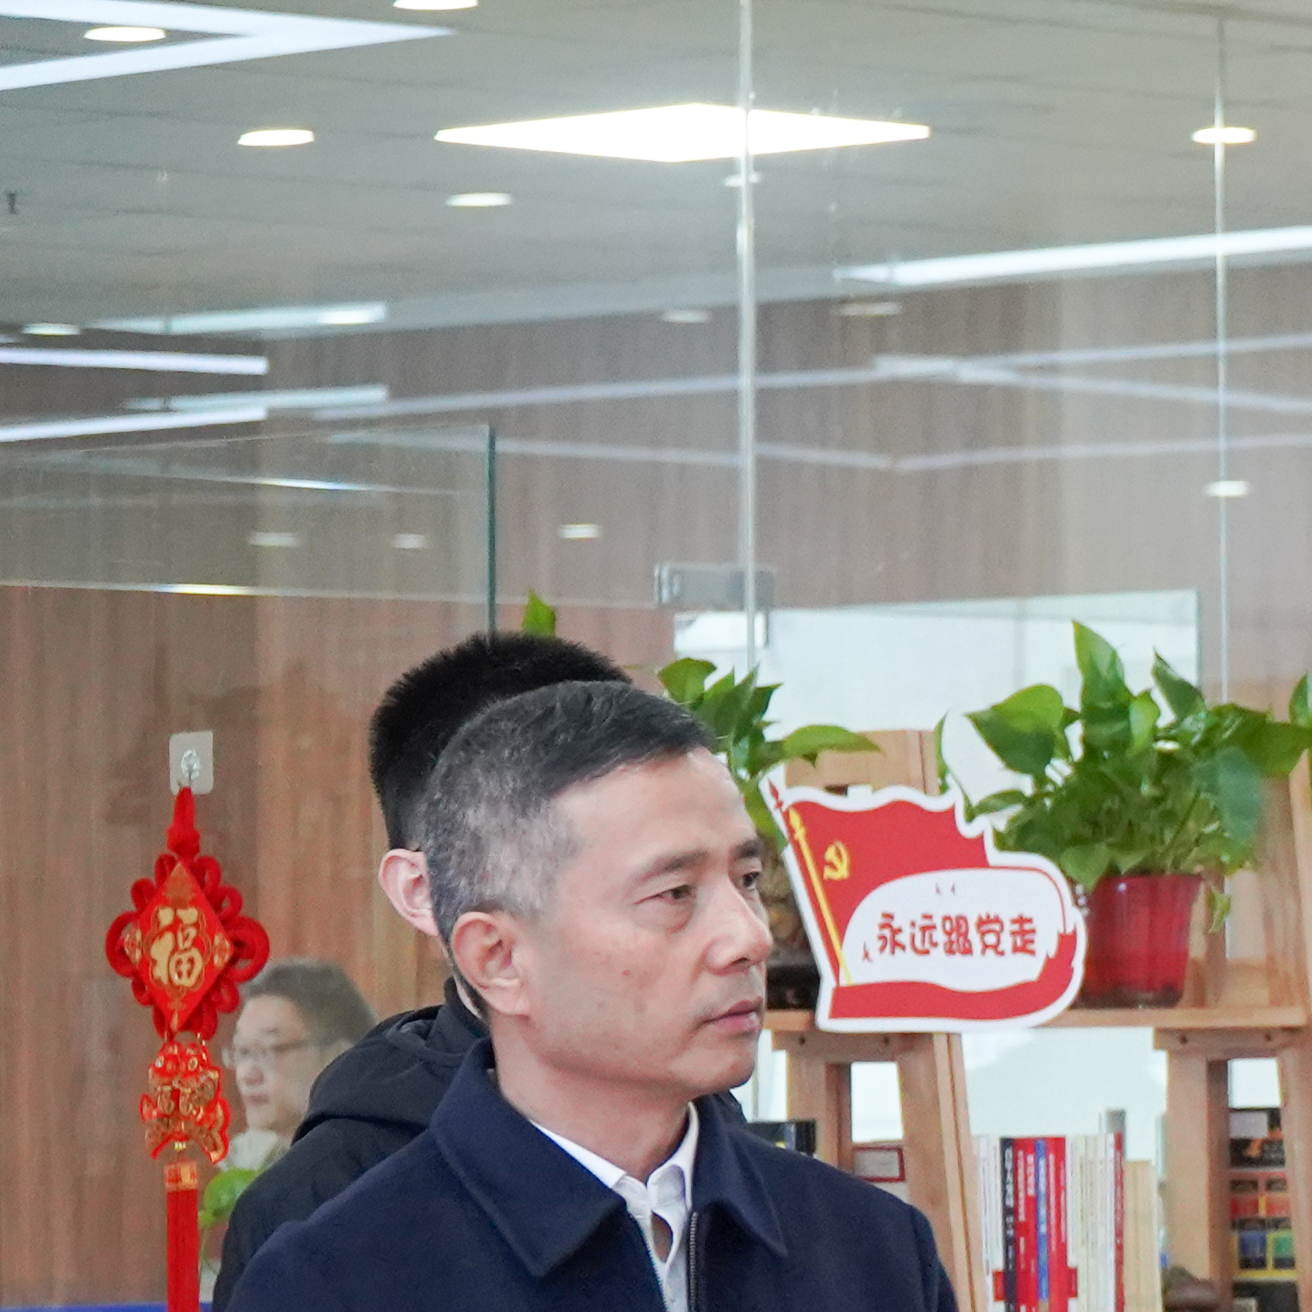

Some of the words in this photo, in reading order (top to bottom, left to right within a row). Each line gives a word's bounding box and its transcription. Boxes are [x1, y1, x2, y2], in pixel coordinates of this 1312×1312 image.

[150, 906, 203, 987] 福
[878, 911, 1036, 957] 永远跟党走
